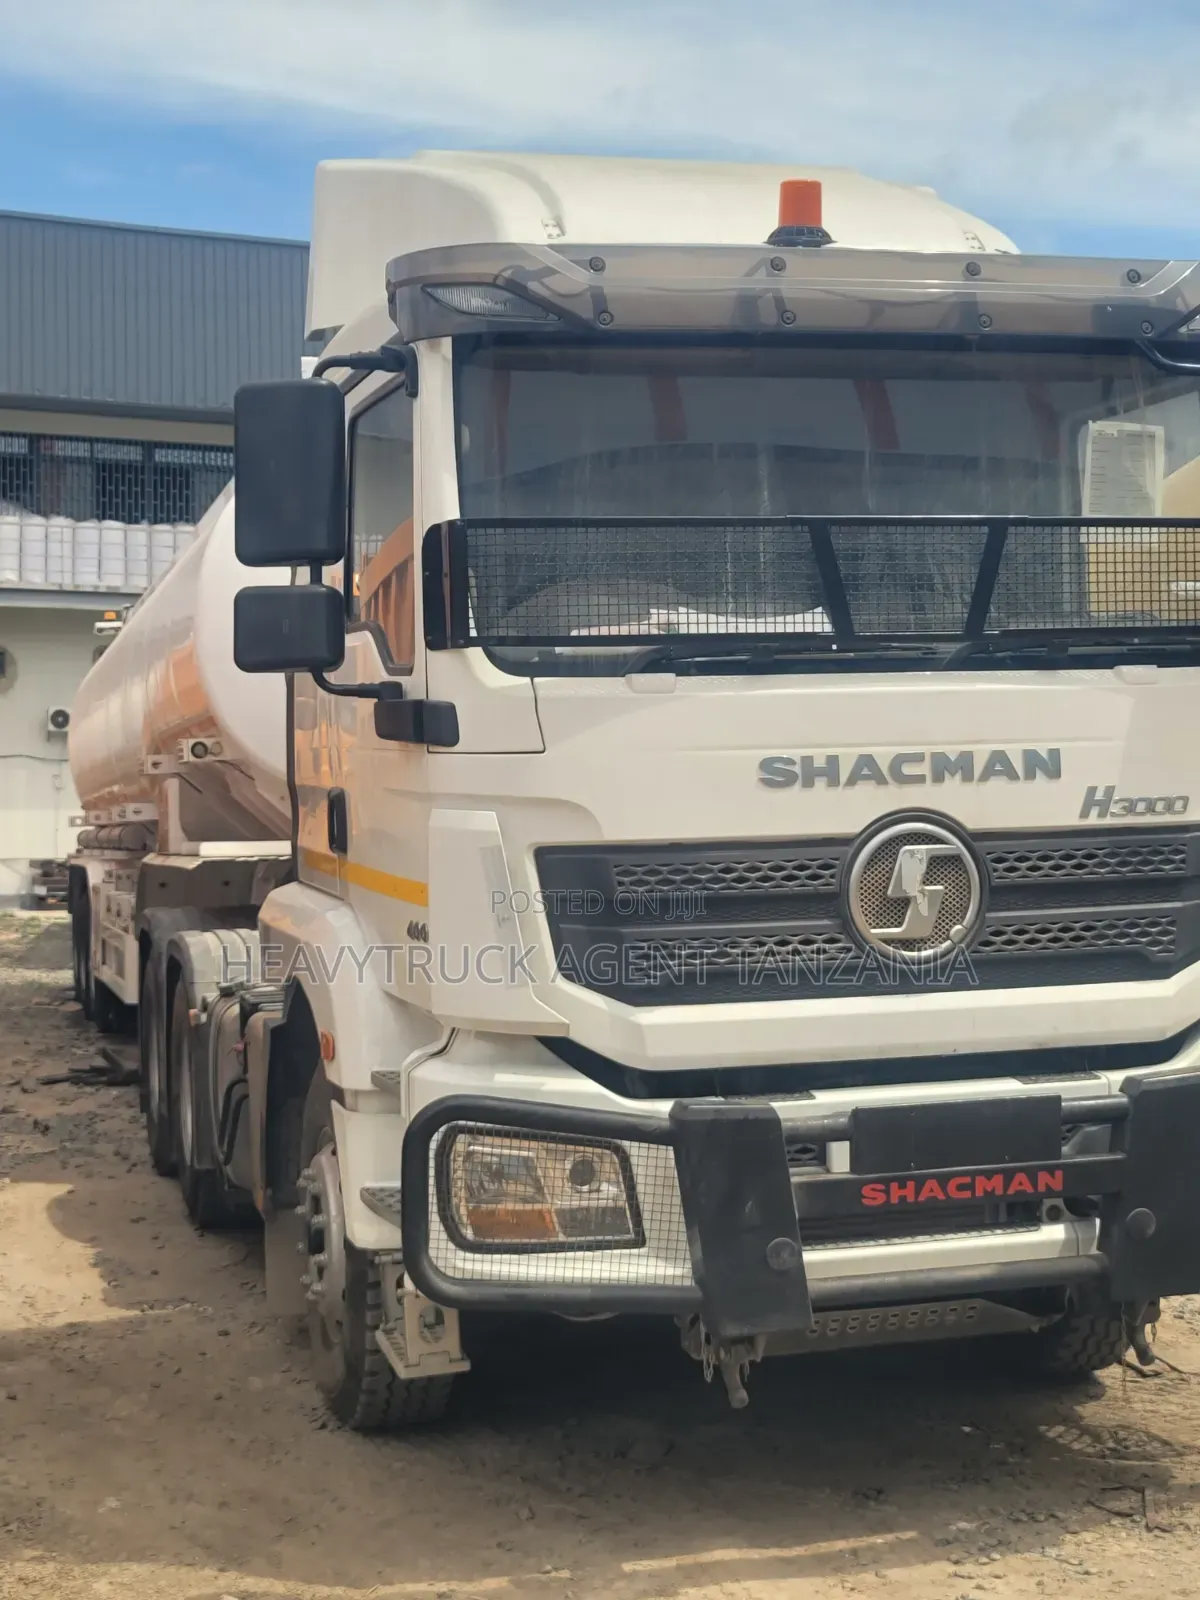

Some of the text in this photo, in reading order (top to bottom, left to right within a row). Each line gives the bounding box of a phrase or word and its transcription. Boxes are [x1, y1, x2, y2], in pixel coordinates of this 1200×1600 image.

[758, 747, 1062, 788] SHACMAN
[1080, 785, 1190, 819] H3000
[861, 1170, 1063, 1206] SHACMAN
